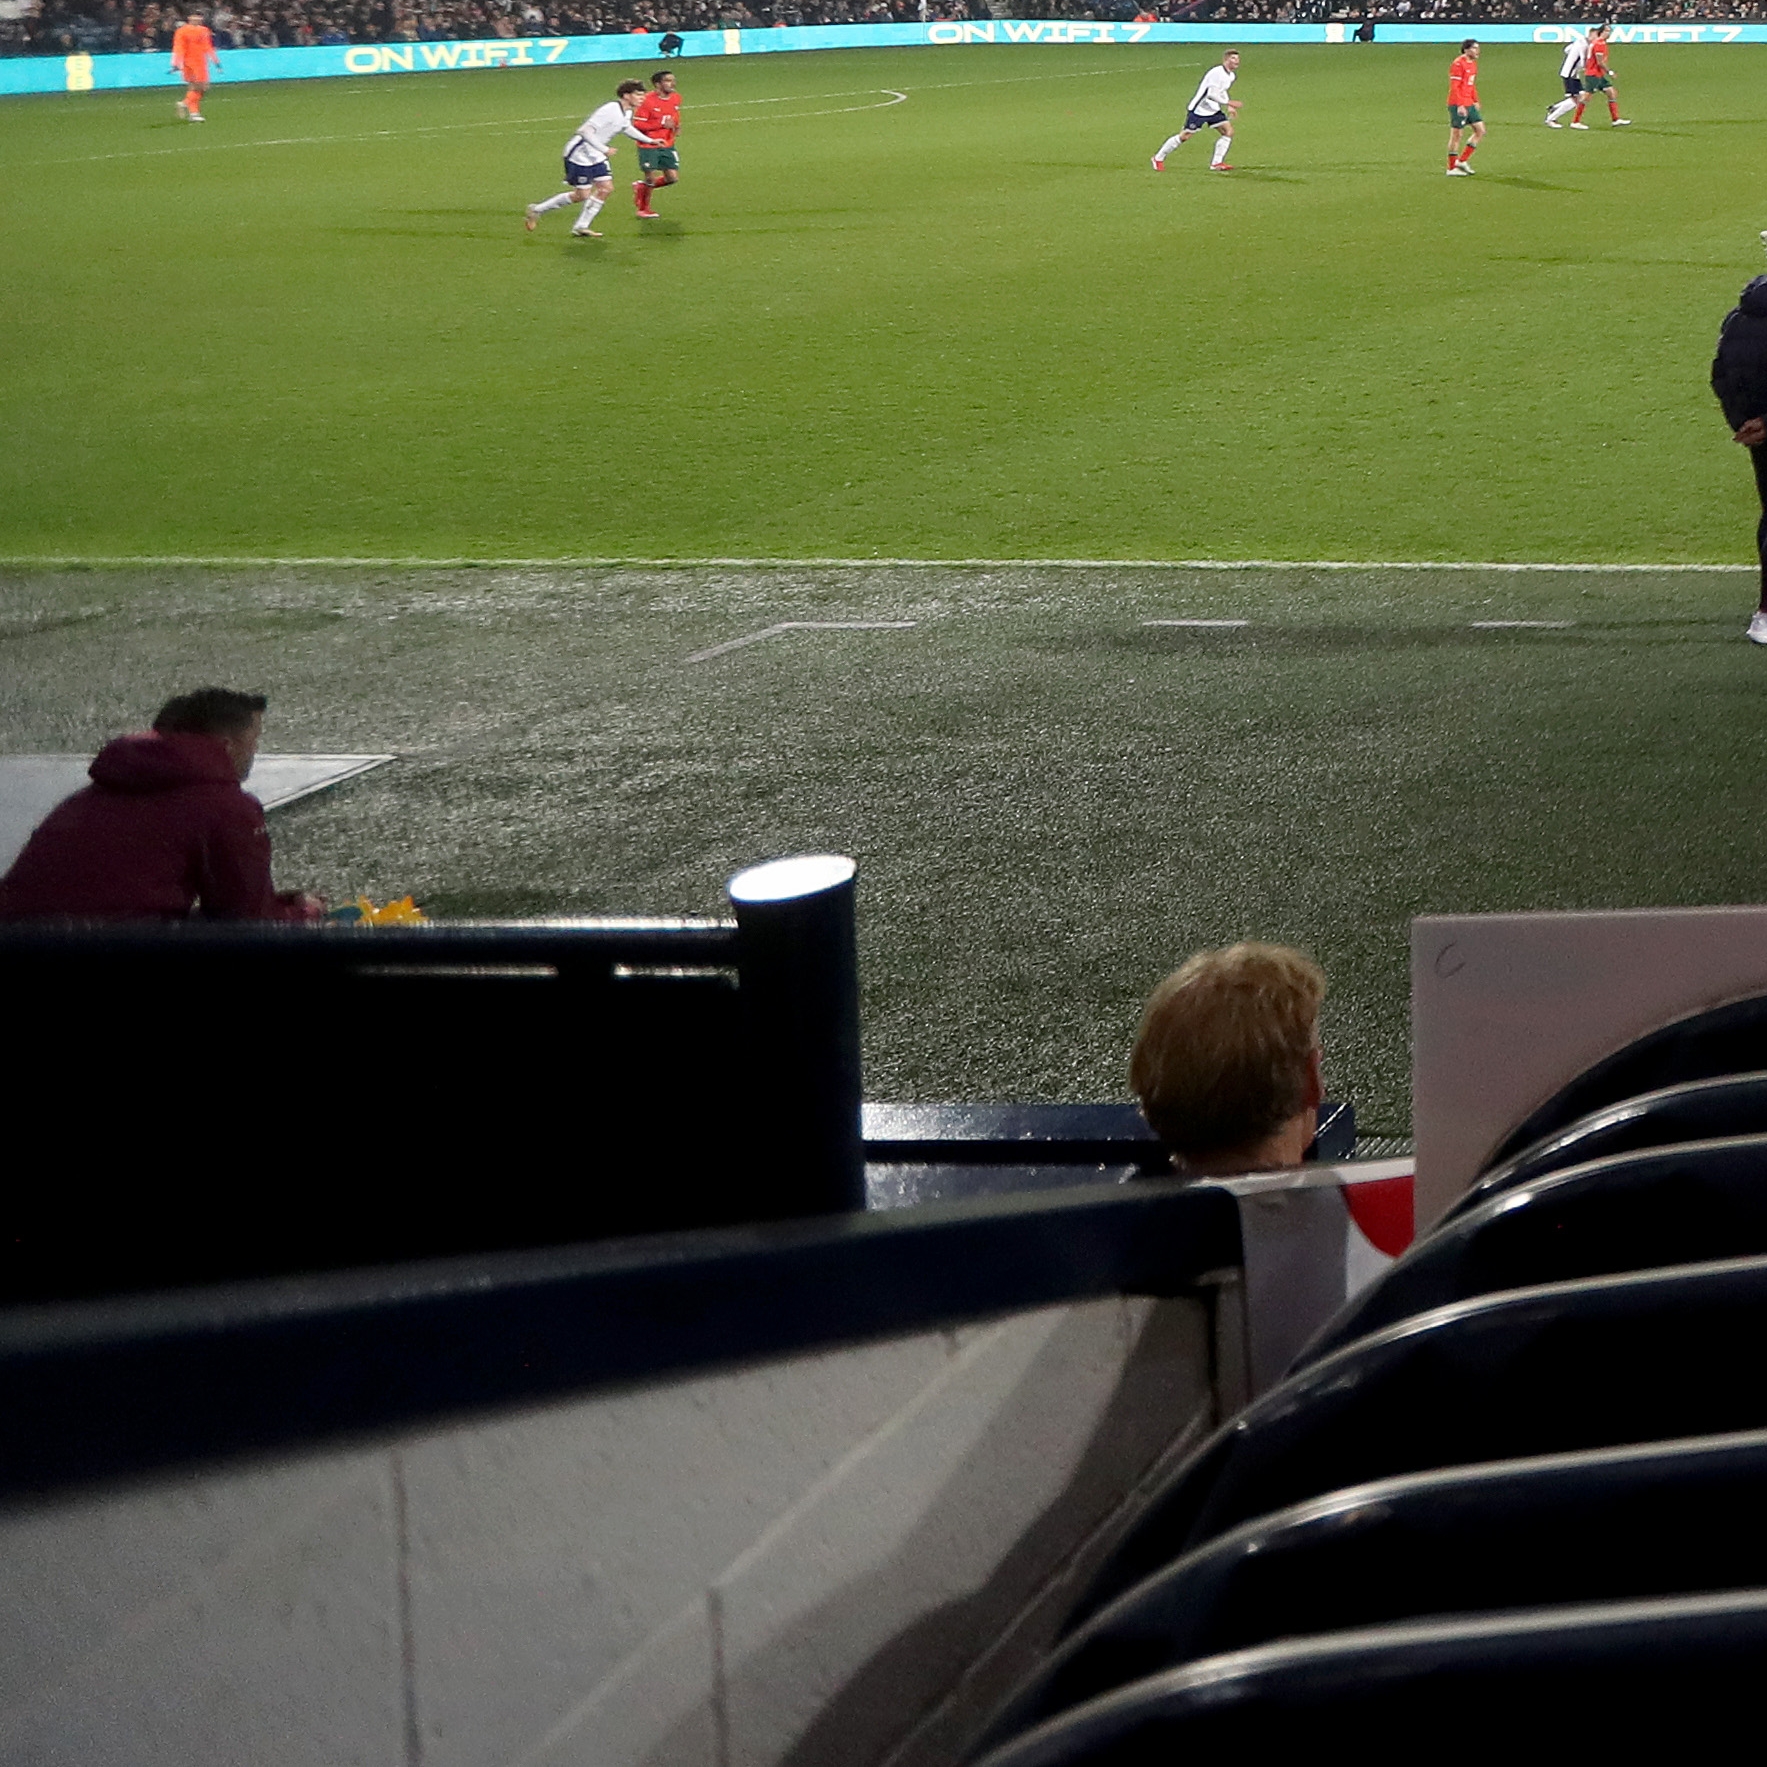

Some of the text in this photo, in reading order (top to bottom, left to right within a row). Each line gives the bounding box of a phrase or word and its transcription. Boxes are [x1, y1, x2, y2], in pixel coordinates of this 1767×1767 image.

[928, 22, 1151, 44] ON WIFI 7
[1711, 26, 1743, 43] 7
[345, 39, 569, 73] ON WIFI 7
